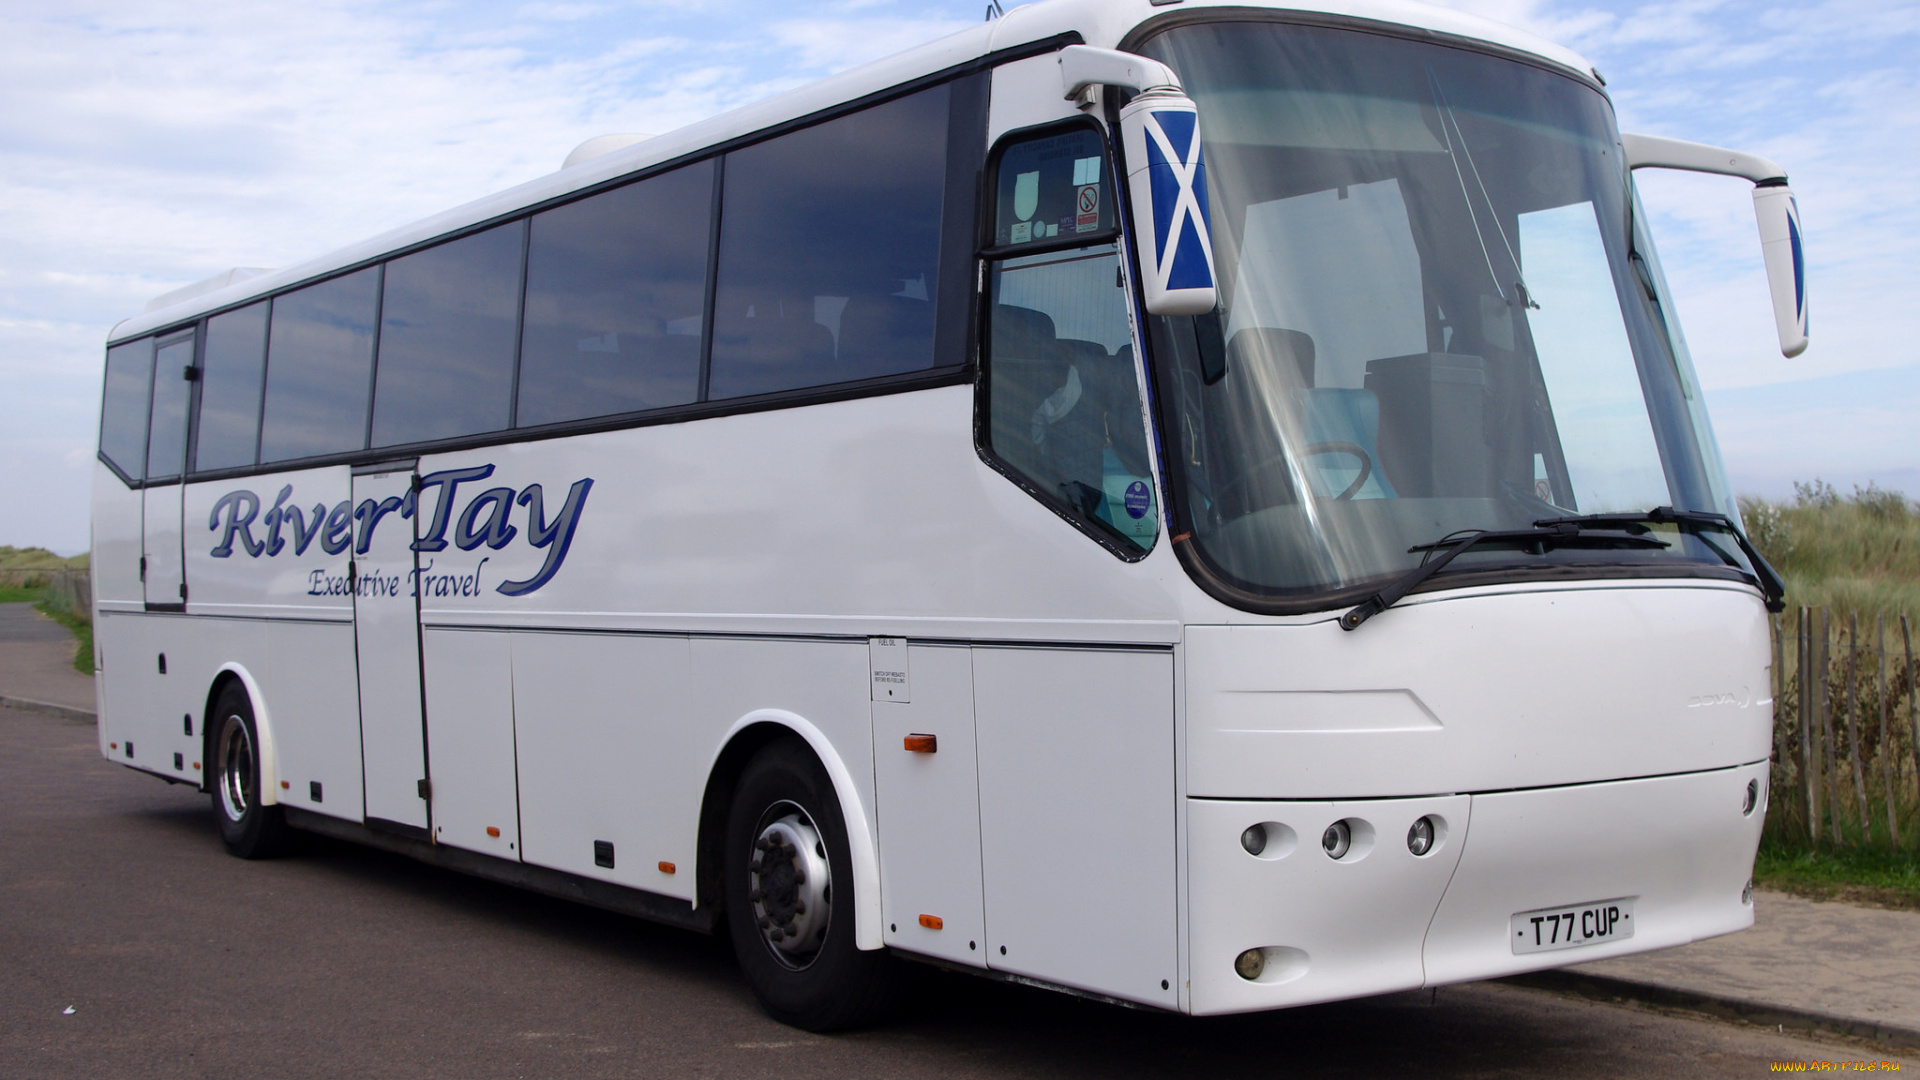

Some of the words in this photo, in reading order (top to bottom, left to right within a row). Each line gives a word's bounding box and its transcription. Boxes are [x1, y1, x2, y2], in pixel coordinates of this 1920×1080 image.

[209, 483, 407, 558] River
[402, 463, 595, 597] Tay
[308, 568, 399, 597] Executive
[407, 557, 489, 598] Travel
[1530, 912, 1575, 946] T77
[1582, 906, 1620, 938] CUP
